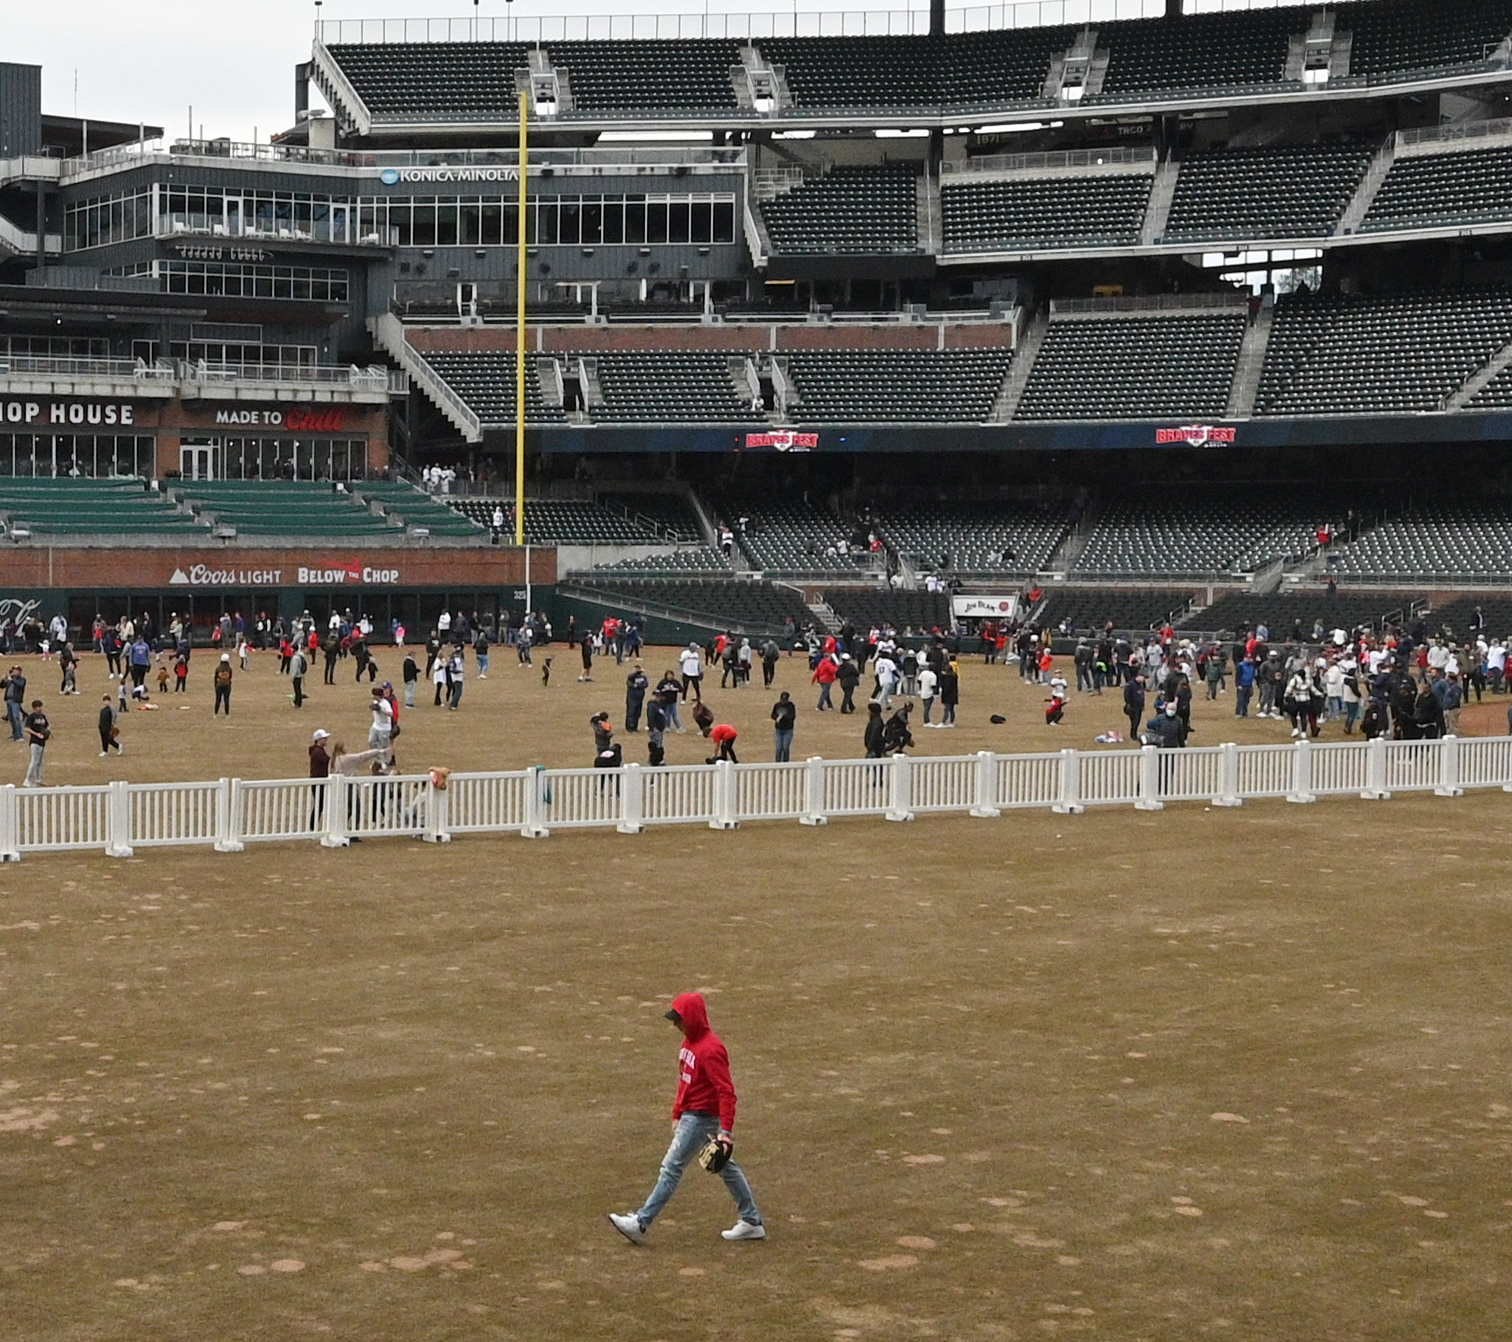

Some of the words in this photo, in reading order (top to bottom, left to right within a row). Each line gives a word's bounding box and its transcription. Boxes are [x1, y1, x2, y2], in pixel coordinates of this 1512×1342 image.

[400, 169, 454, 182] KONICA
[457, 169, 520, 182] MINOLTA
[50, 401, 135, 426] HOUSE
[215, 409, 260, 425] MADE
[261, 410, 283, 426] TO
[285, 407, 347, 432] Chill
[189, 563, 237, 584] Coors
[239, 569, 282, 584] LIGHT
[297, 566, 347, 584] BELOW
[362, 566, 400, 584] CHOP
